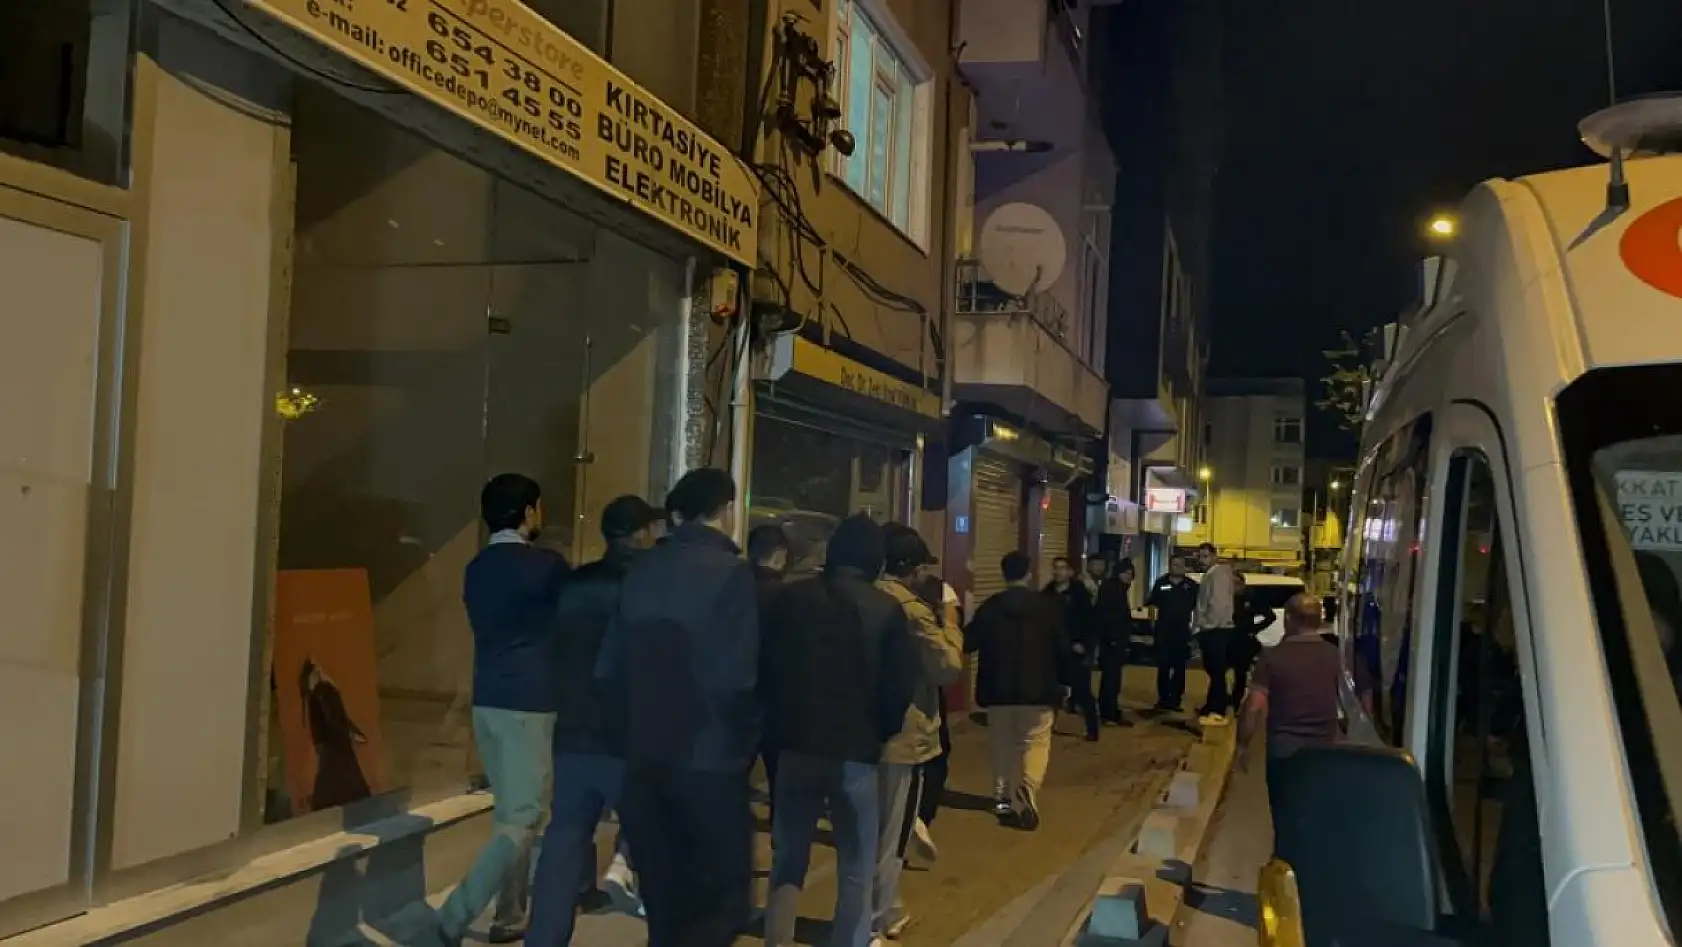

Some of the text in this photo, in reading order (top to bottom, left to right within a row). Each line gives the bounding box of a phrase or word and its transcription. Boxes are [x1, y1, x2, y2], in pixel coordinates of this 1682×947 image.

[306, 0, 580, 161] e-mail: officedepo@mynet.com
[426, 40, 581, 140] 651 45 55
[427, 12, 495, 66] 654
[502, 58, 541, 92] 38
[549, 87, 582, 117] 00
[464, 0, 584, 81] perstore
[598, 111, 752, 228] BÜRO MOBİLYA
[606, 80, 721, 179] KIRTASİYE
[605, 154, 741, 251] ELEKTRONİK
